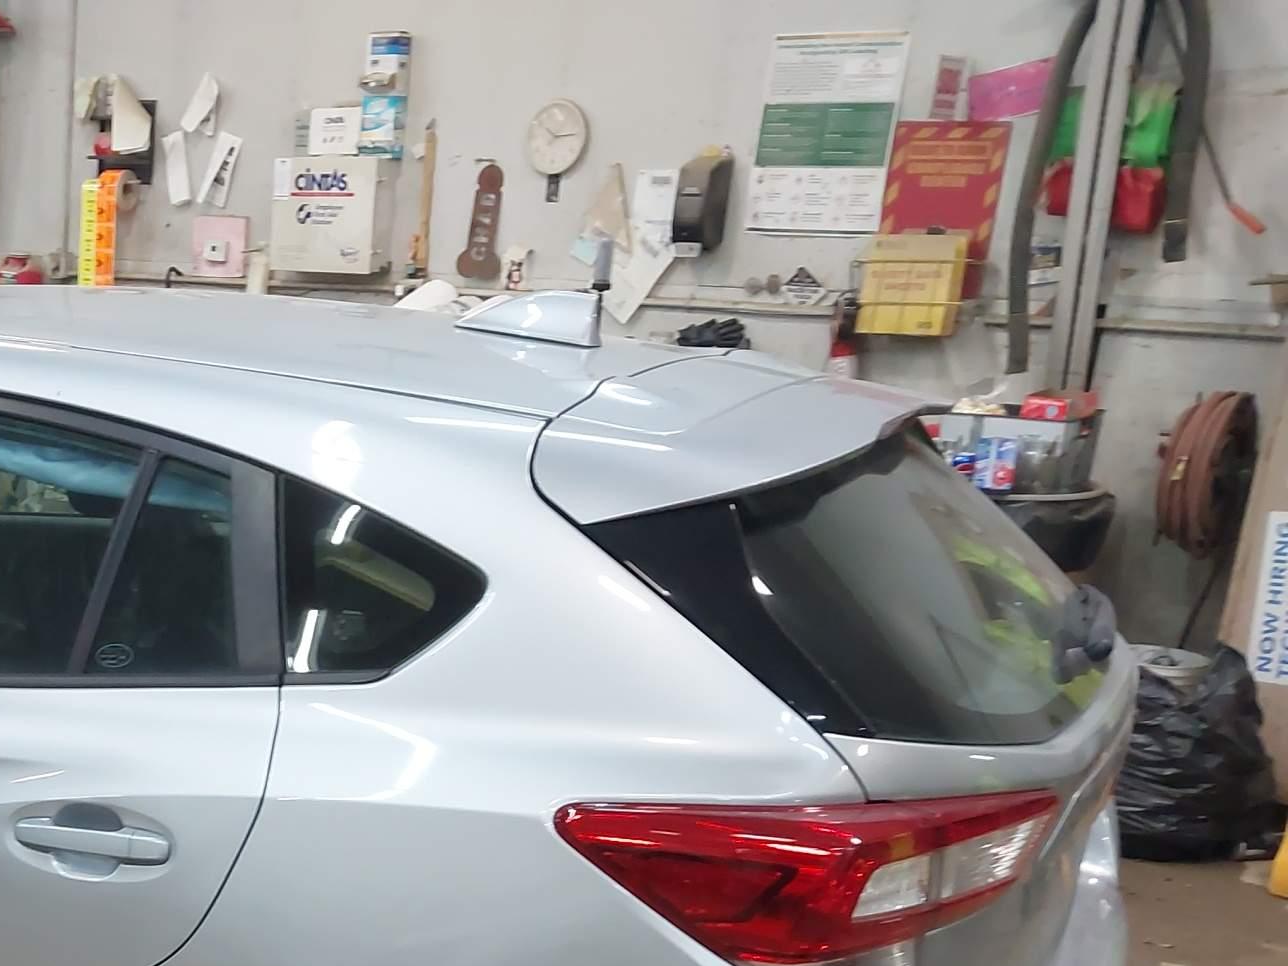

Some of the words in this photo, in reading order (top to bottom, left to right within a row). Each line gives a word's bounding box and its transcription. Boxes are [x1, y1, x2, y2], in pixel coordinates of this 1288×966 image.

[295, 167, 347, 191] CINTAS
[470, 193, 497, 261] CHAD
[1256, 612, 1279, 672] NOW
